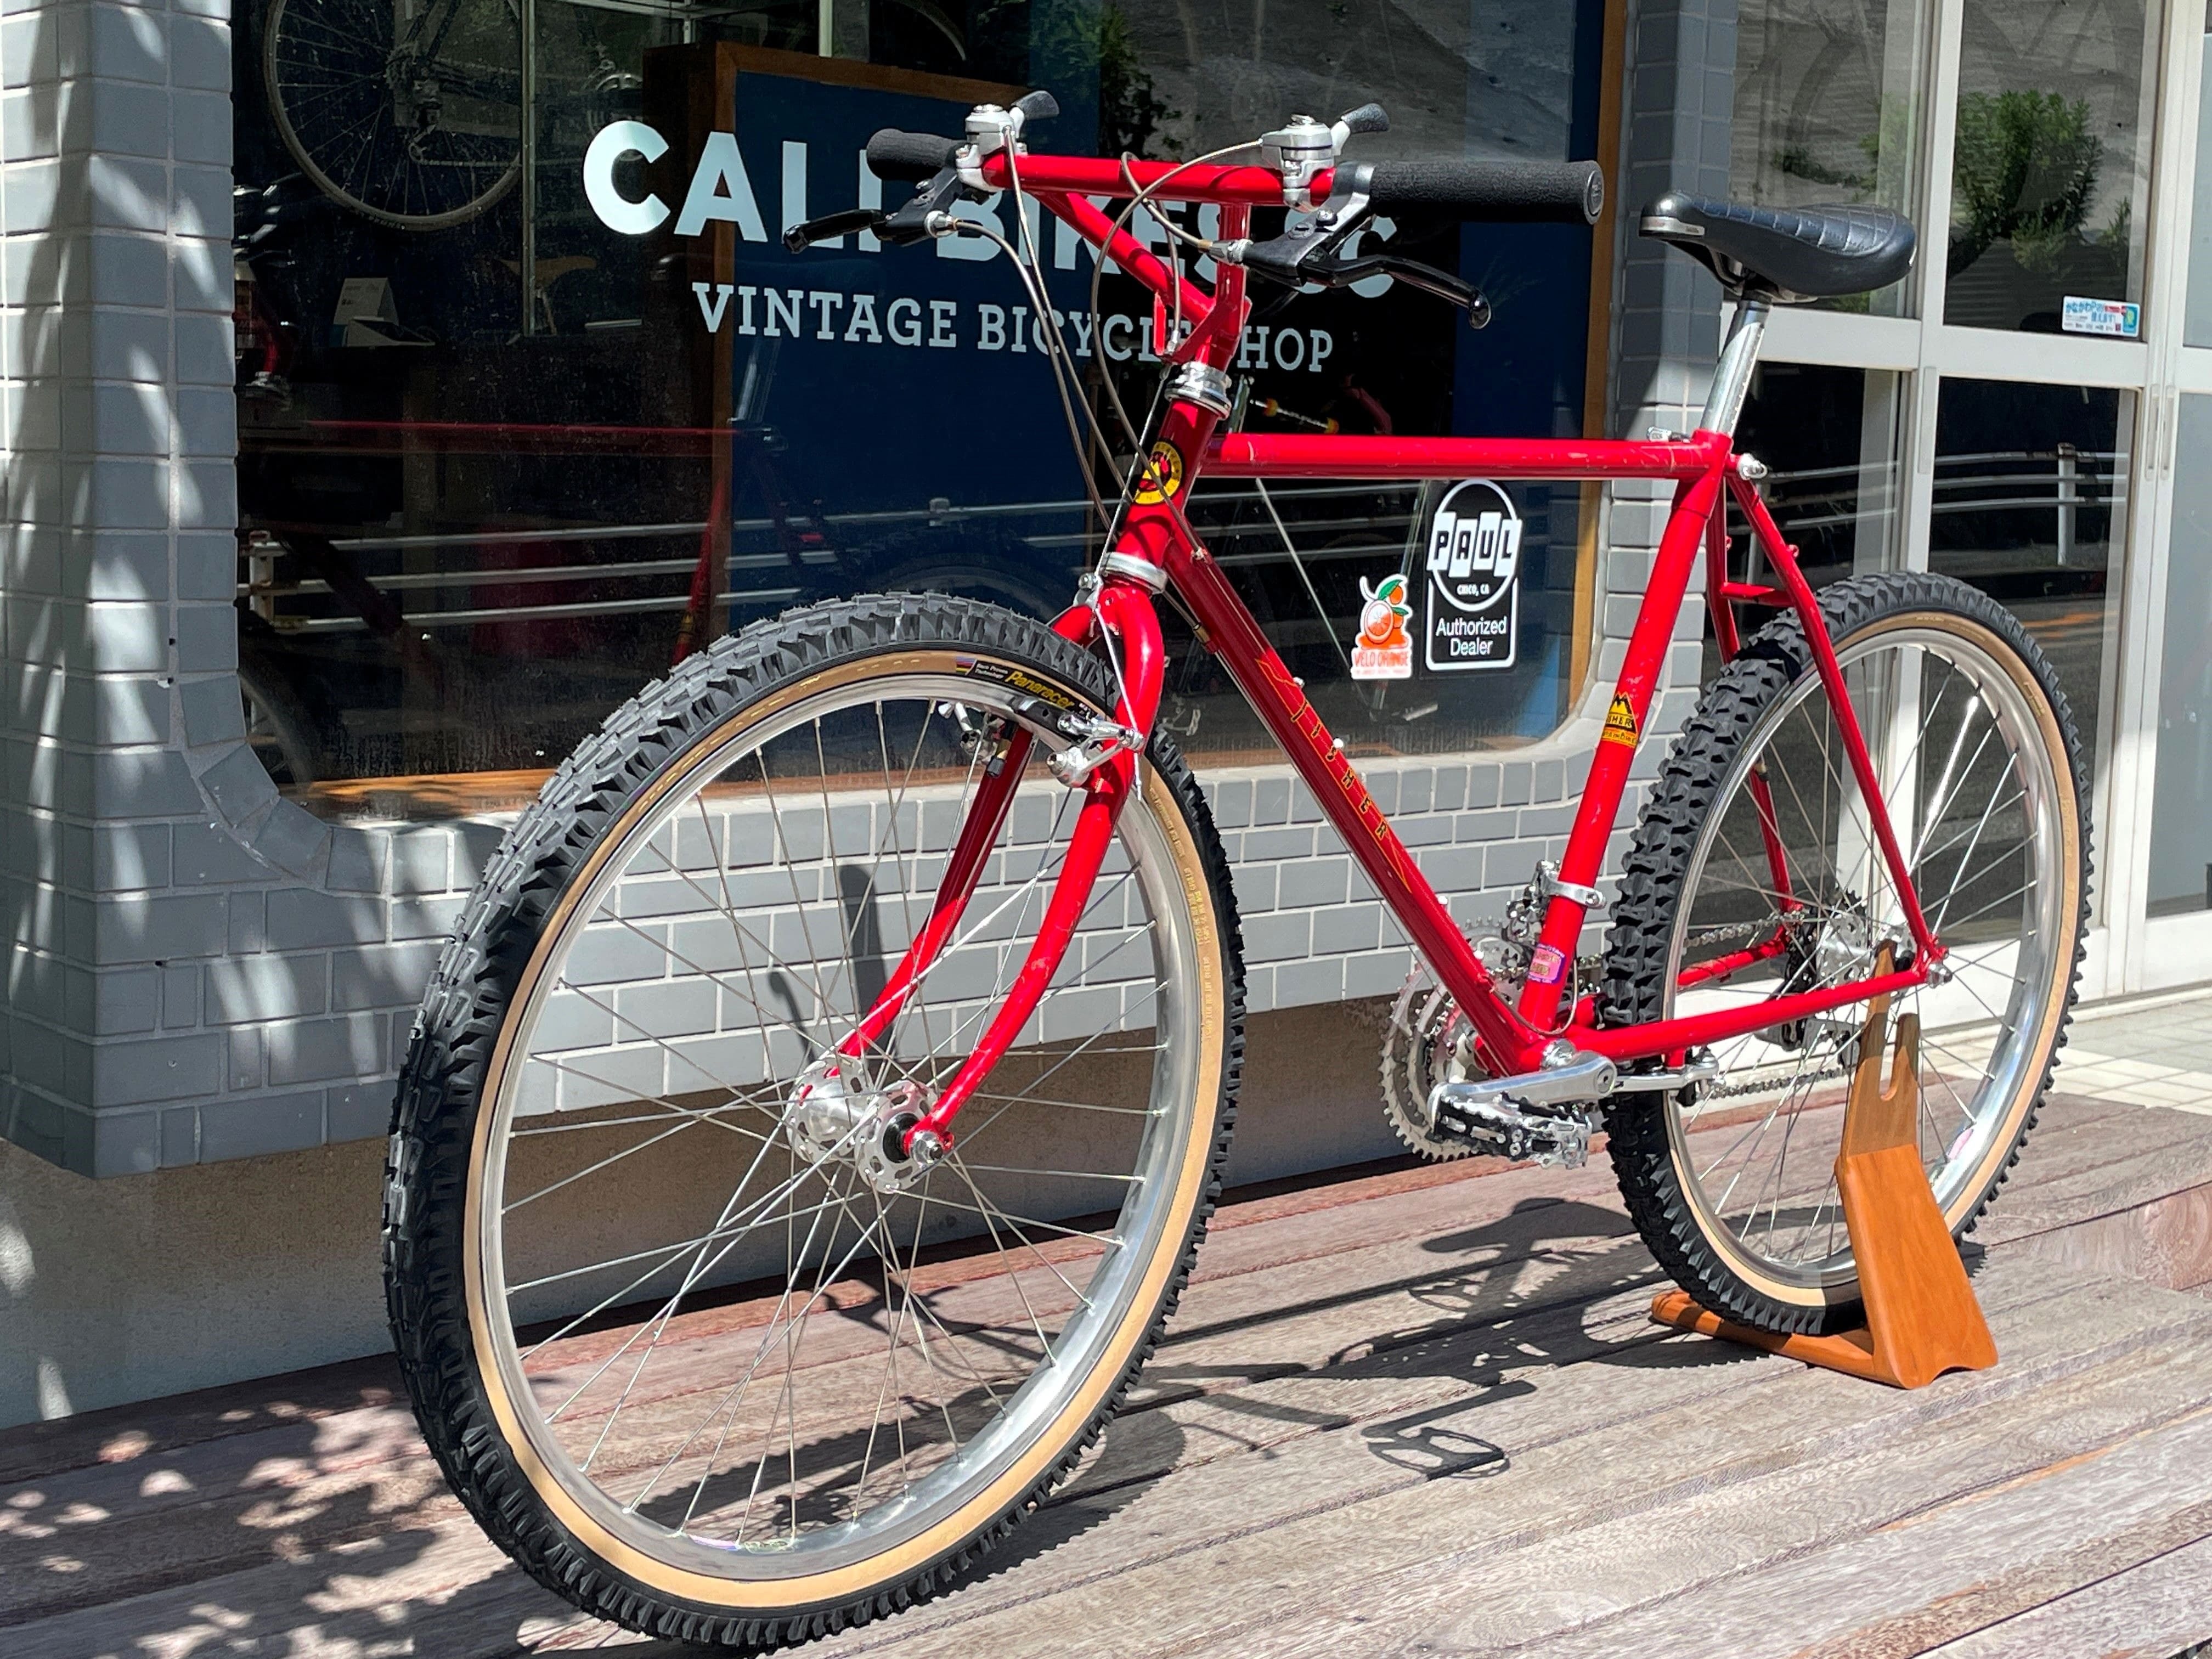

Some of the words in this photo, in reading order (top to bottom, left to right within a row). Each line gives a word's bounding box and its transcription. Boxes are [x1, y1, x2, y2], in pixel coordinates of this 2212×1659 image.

[583, 120, 882, 252] CALI
[692, 282, 956, 348] VINTAGE
[1237, 325, 1333, 373] HOP
[1433, 530, 1513, 560] PAUL
[1436, 617, 1507, 637] Authorized
[1353, 651, 1375, 667] VELO
[1450, 638, 1493, 657] Dealer
[1005, 670, 1075, 709] Panaracer
